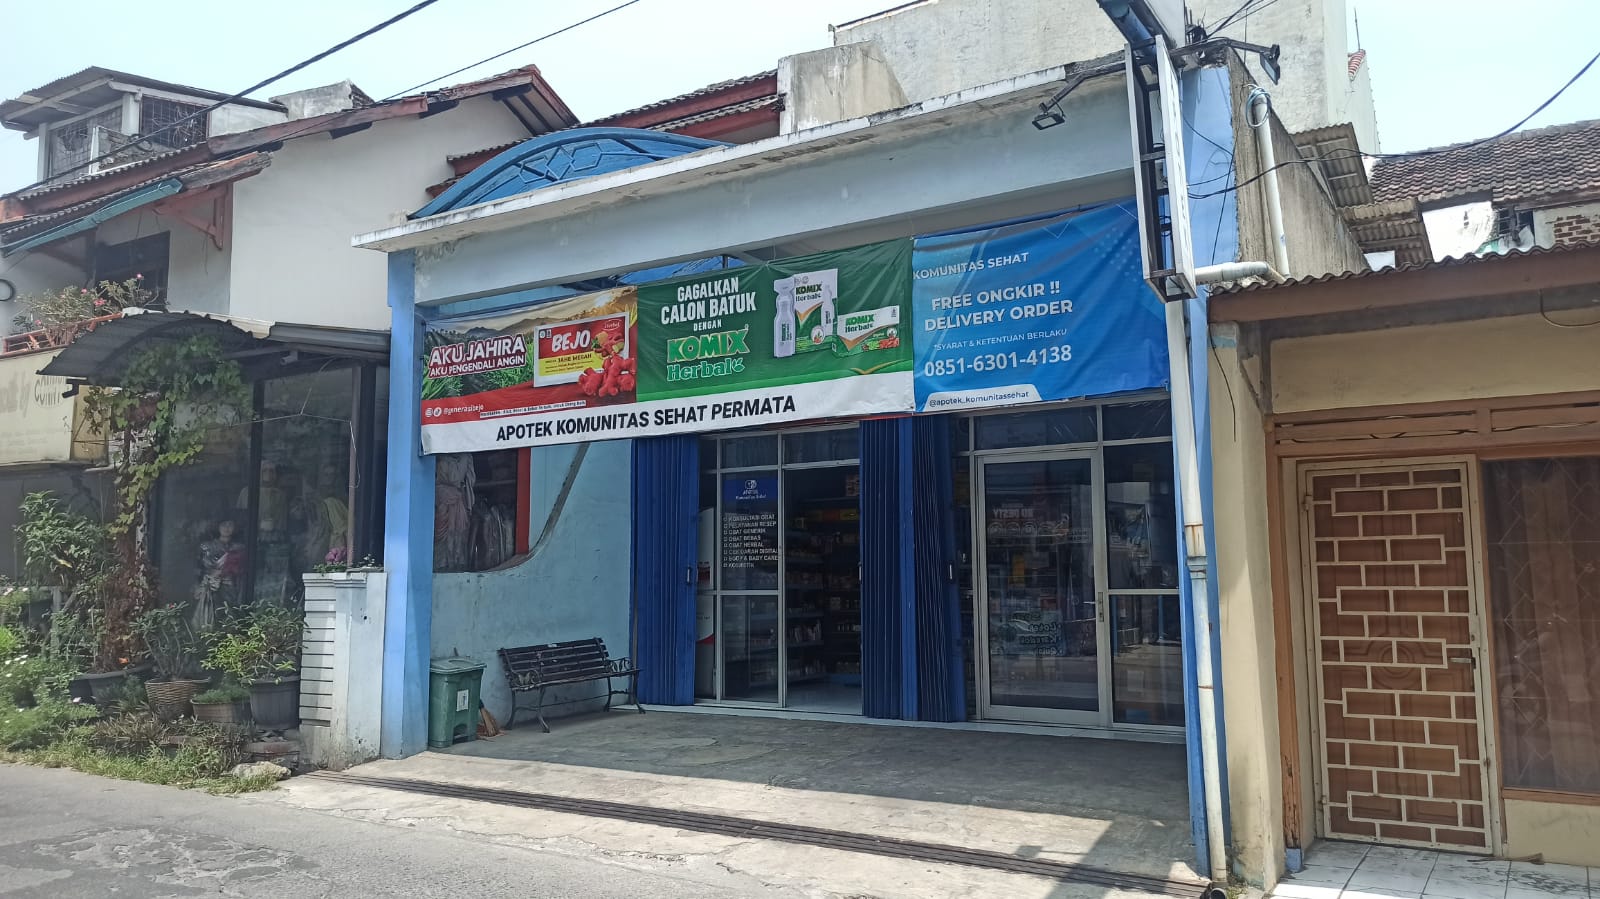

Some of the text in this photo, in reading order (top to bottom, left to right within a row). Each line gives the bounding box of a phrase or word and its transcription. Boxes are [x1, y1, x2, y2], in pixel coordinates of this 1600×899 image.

[913, 252, 1029, 280] KOMUNITAS SEHAT
[677, 277, 739, 302] GAGALKAN
[795, 283, 822, 295] KOMIX
[931, 280, 1060, 311] FREE ONGKIR !!
[661, 292, 757, 325] CALON BATUK
[845, 314, 875, 325] KOMIX
[924, 299, 1073, 332] DELIVERY ORDER
[693, 319, 722, 331] DENGAN
[976, 334, 1025, 347] KETENTUAN
[1027, 328, 1068, 340] BERLAKU
[429, 336, 525, 366] AKU JAHIRA
[551, 329, 591, 353] BEJO
[667, 328, 750, 363] KOMIX
[430, 354, 525, 377] AKU PENGENDALI ANGIN
[666, 358, 733, 381] Herbal
[924, 345, 1072, 377] 0851-6301-4138
[929, 391, 1029, 407] @apotek_komunitassehat
[496, 395, 796, 441] APOTEK KOMUNITAS SEHAT PERMATA
